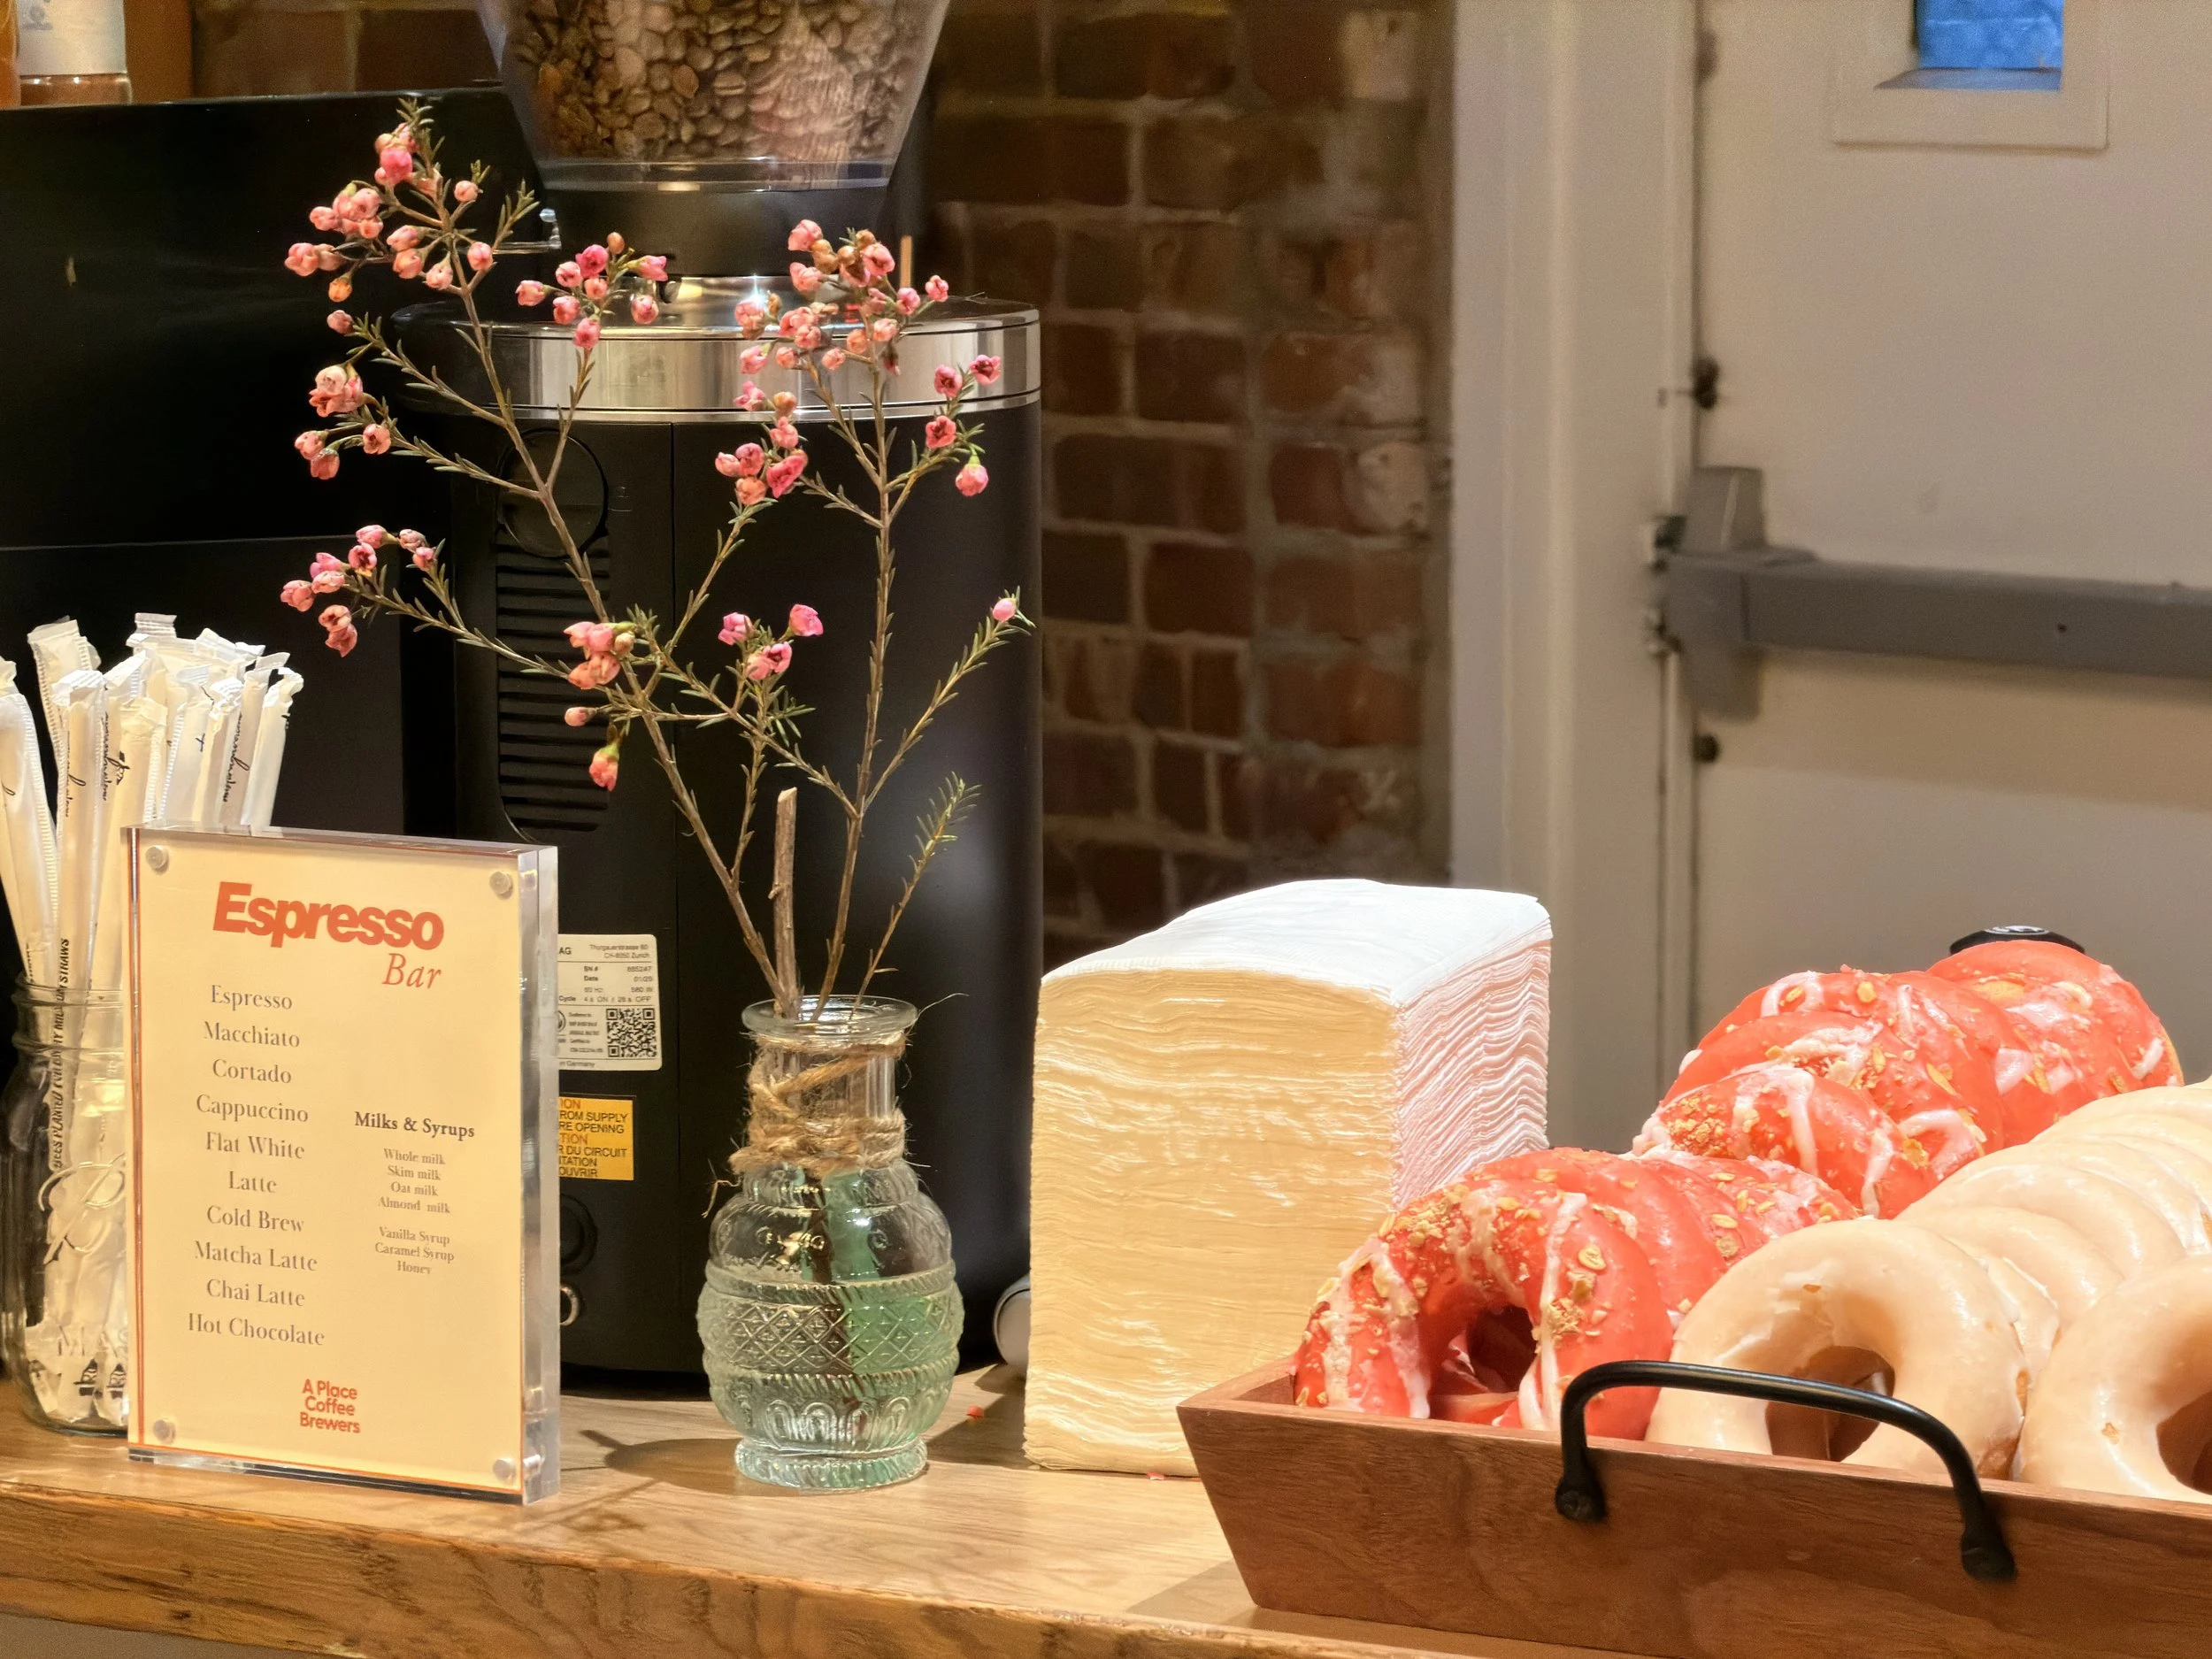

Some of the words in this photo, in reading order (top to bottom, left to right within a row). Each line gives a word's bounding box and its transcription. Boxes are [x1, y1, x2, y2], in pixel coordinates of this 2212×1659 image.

[212, 881, 444, 950] Espresso
[58, 938, 70, 983] STRAWS
[558, 947, 572, 956] AG
[382, 953, 442, 989] Bar
[211, 985, 293, 1011] Espresso
[204, 1021, 300, 1048] Macchiato
[212, 1058, 292, 1083] Cortado
[196, 1094, 309, 1122] Cappuccino
[560, 1099, 580, 1109] ION
[355, 1111, 397, 1129] Milks
[403, 1117, 418, 1132] &
[422, 1118, 475, 1141] Syrups
[559, 1121, 572, 1131] RE
[575, 1123, 625, 1133] OPENING
[560, 1110, 583, 1120] ROM
[587, 1112, 627, 1123] SUPPLY
[206, 1132, 241, 1153] Flat
[248, 1135, 305, 1159] White
[559, 1133, 588, 1145] TION
[383, 1148, 419, 1162] Whole
[421, 1154, 446, 1164] milk
[566, 1145, 580, 1155] DU
[584, 1147, 627, 1157] CIRCUIT
[228, 1171, 277, 1193] Latte
[388, 1165, 414, 1178] Skim
[418, 1169, 441, 1180] milk
[390, 1181, 411, 1193] Oat
[414, 1185, 438, 1196] milk
[378, 1196, 420, 1210] Almond
[426, 1202, 450, 1213] milk
[207, 1205, 250, 1227] Cold
[258, 1210, 304, 1232] Brew
[379, 1226, 416, 1240] Vanilla
[419, 1231, 450, 1247] Syrup
[195, 1240, 262, 1265] Matcha
[270, 1248, 318, 1271] Latte
[375, 1242, 420, 1256] Caramel
[423, 1247, 455, 1263] Syrup
[397, 1260, 431, 1274] Honey
[207, 1279, 250, 1301] Chai
[257, 1284, 305, 1306] Latte
[188, 1313, 221, 1334] Hot
[229, 1317, 325, 1345] Chocolate
[302, 1379, 313, 1394] A
[317, 1380, 357, 1400] Place
[305, 1395, 356, 1416] Coffee
[300, 1411, 360, 1433] Brewers
